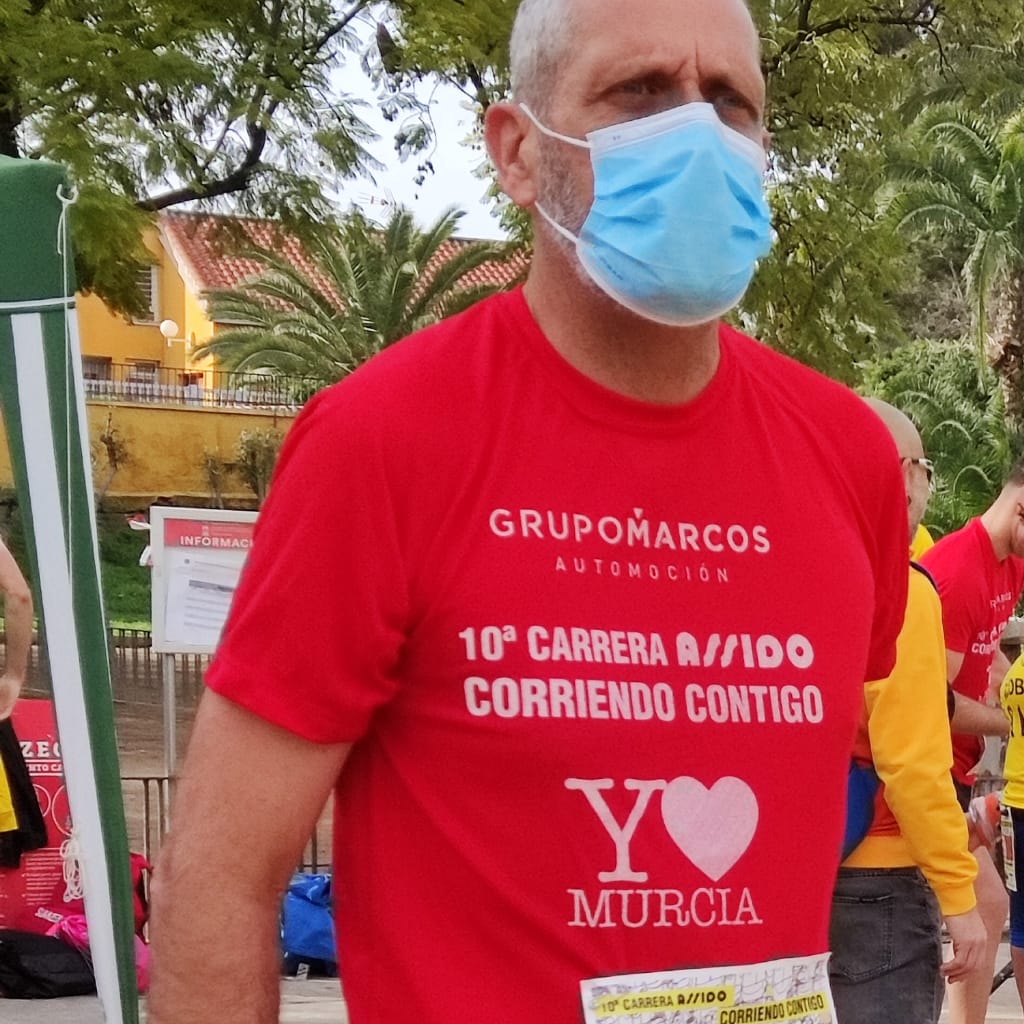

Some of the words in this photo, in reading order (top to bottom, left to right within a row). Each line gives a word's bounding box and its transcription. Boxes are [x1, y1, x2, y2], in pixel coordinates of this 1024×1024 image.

[555, 556, 729, 583] AUTOMOCIÓN
[527, 625, 668, 666] CARRERA
[463, 677, 676, 721] CORRIENDO
[686, 685, 824, 724] CONTIGO
[564, 777, 669, 882] Y
[566, 887, 763, 928] MURCIA
[623, 995, 674, 1011] CARRERA
[786, 994, 824, 1017] CONTIGO
